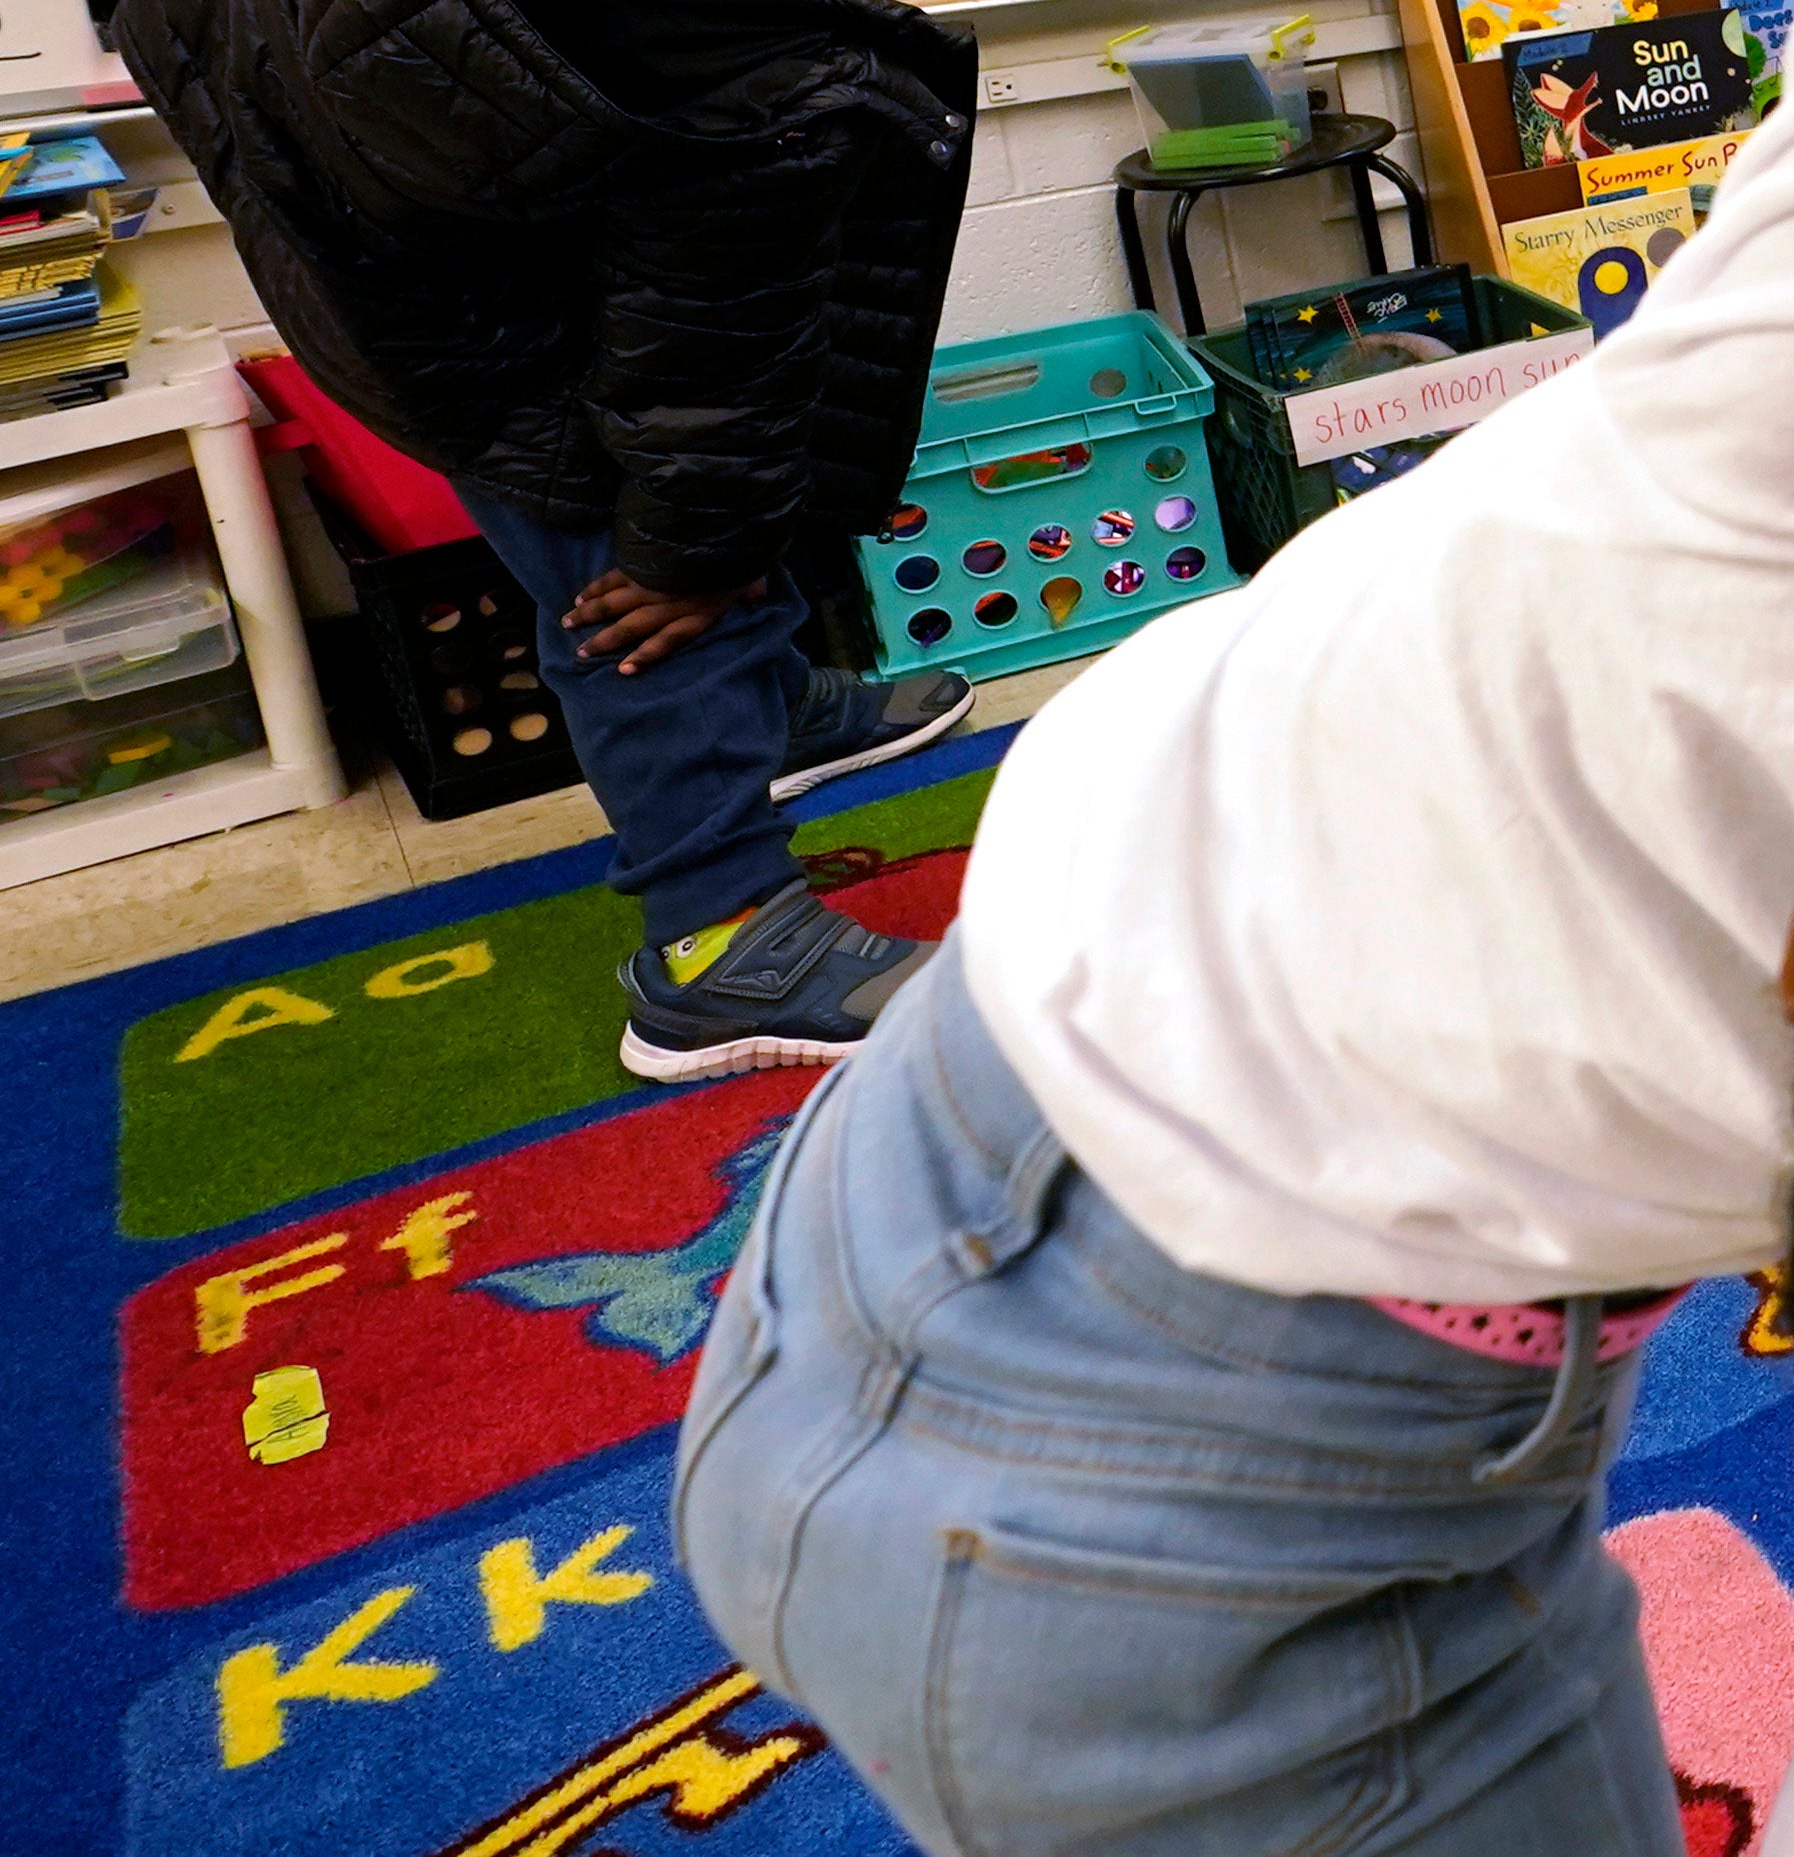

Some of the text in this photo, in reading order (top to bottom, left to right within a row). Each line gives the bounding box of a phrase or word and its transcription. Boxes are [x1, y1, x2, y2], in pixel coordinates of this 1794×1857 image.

[1633, 39, 1689, 67] Sun
[1647, 55, 1702, 87] and
[1615, 82, 1709, 115] Moon
[1620, 105, 1711, 127] LINDSEY YANKEY
[1586, 161, 1675, 193] Summer
[1682, 152, 1718, 177] Sun
[1514, 204, 1683, 252] Starry Messenger
[1314, 364, 1503, 445] stars moon
